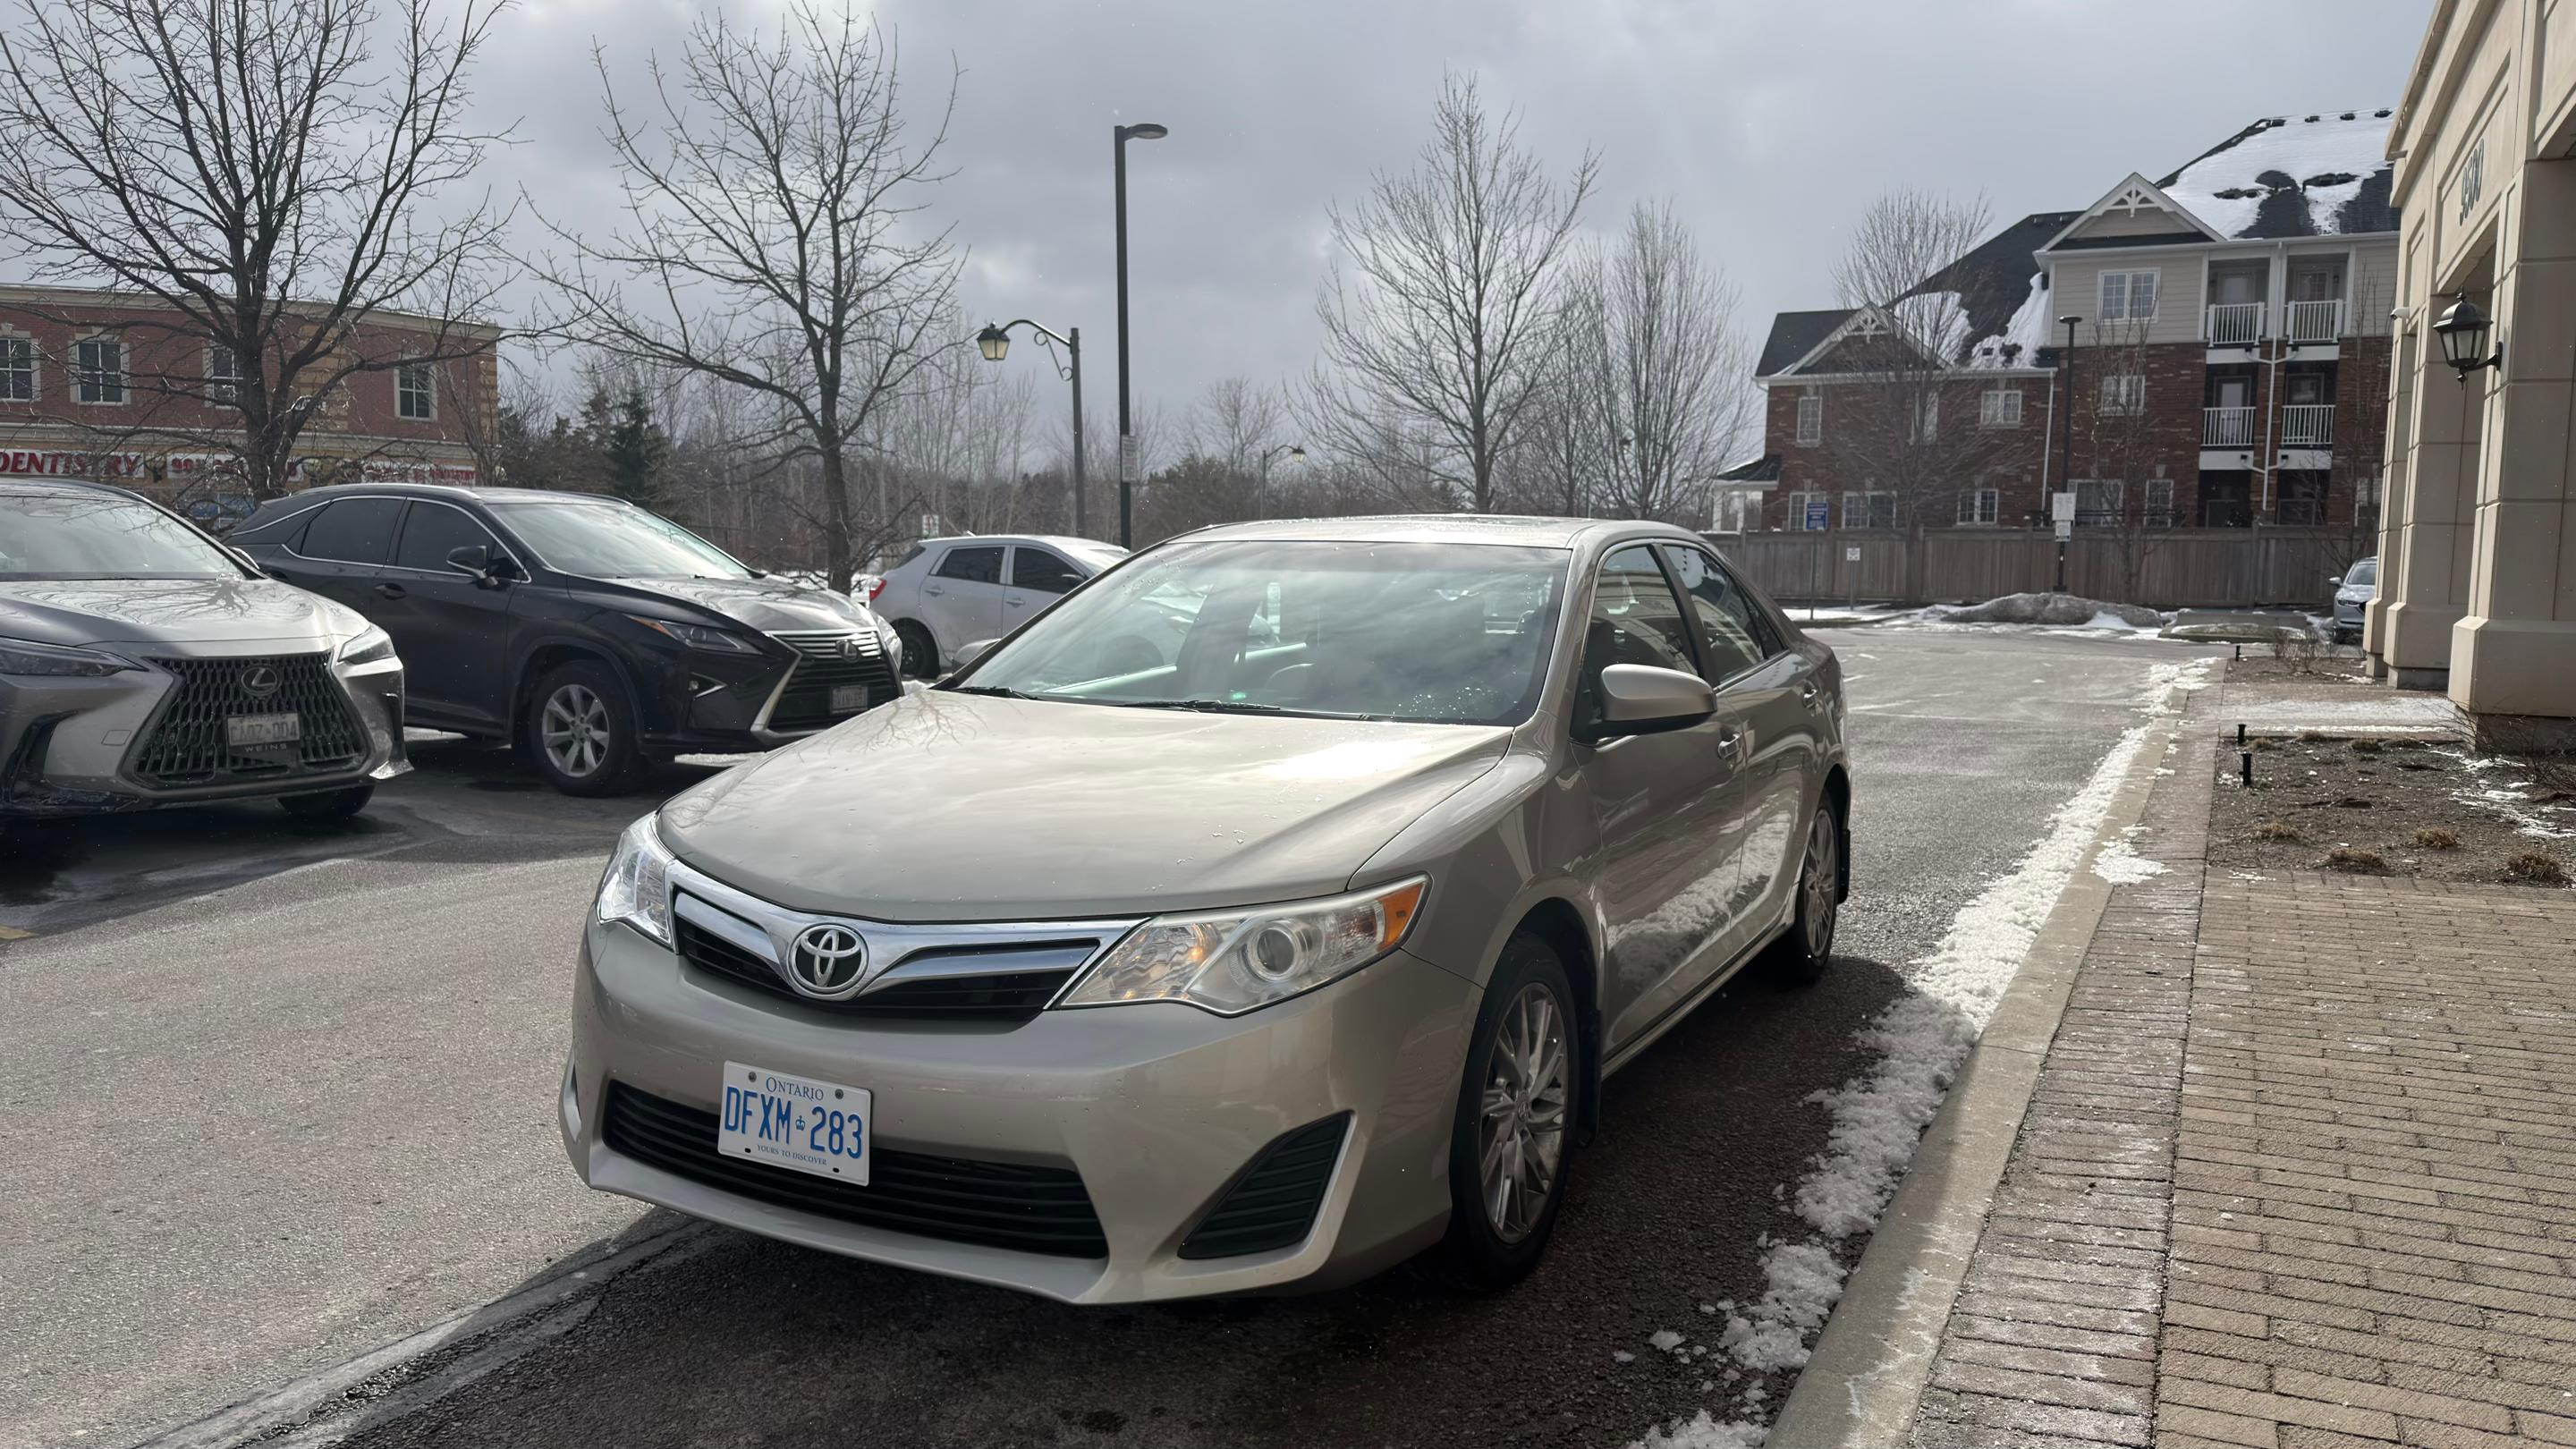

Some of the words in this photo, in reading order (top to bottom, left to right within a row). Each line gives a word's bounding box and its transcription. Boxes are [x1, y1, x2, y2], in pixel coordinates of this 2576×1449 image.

[0, 451, 140, 474] DENTISRY
[724, 1086, 792, 1145] DFXM
[809, 1106, 862, 1159] 283
[757, 1143, 779, 1156] YOURS
[781, 1148, 792, 1158] TO
[792, 1151, 827, 1165] DISCOVER
